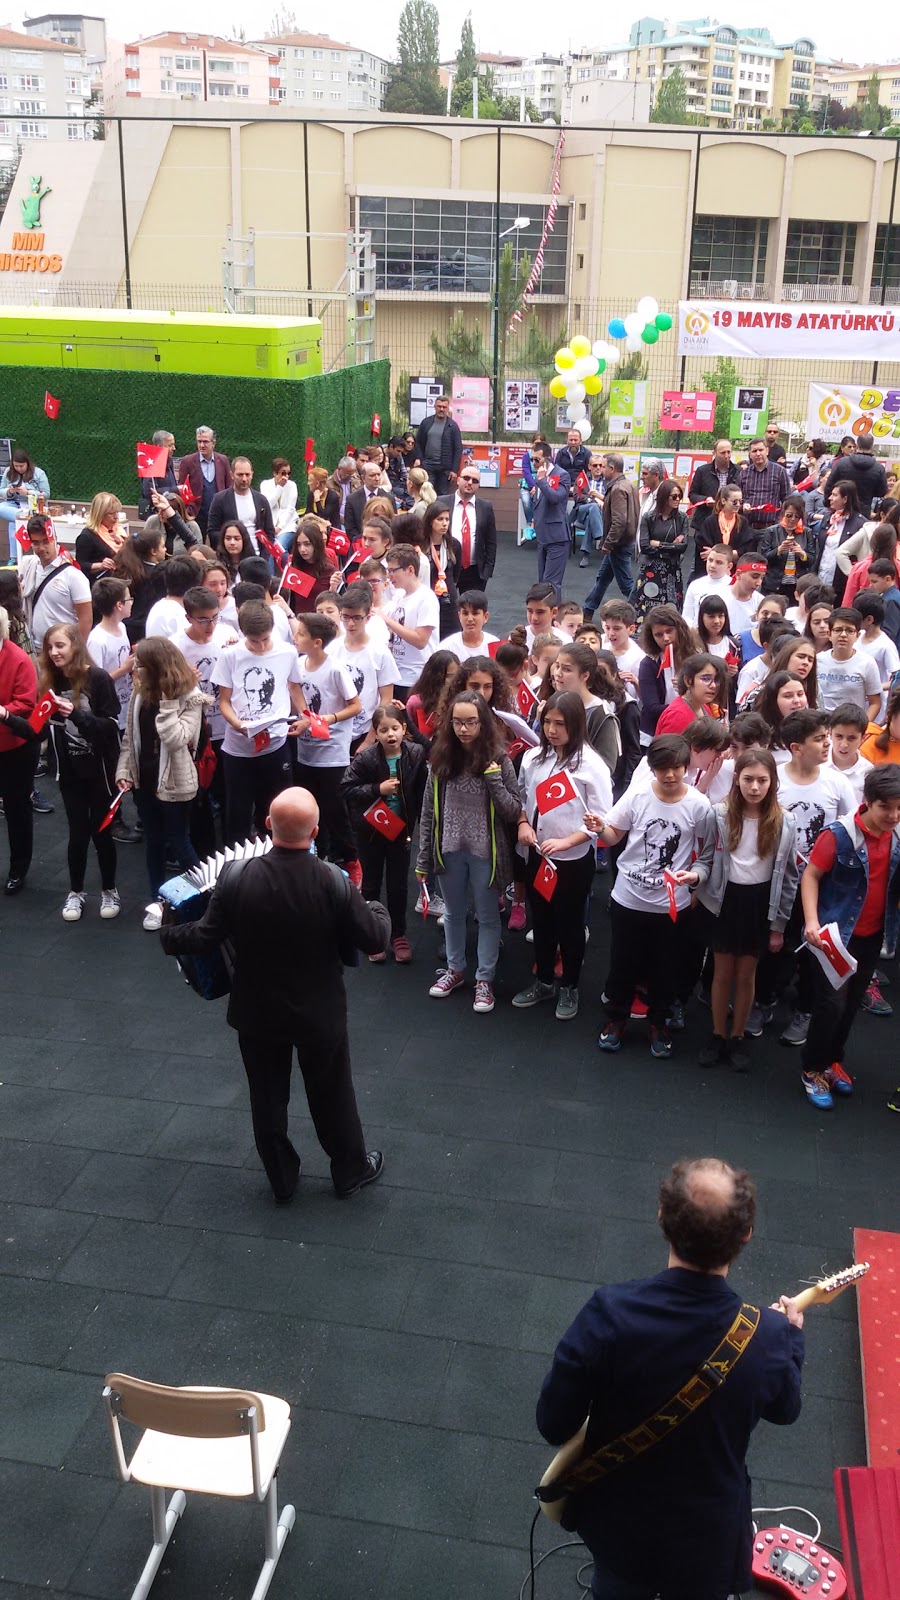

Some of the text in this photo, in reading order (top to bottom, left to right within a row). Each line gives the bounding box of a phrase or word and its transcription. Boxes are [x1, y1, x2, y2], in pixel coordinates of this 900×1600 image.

[12, 232, 45, 251] MM
[712, 309, 895, 332] 19 MAYIS ATATÜRK'Ü
